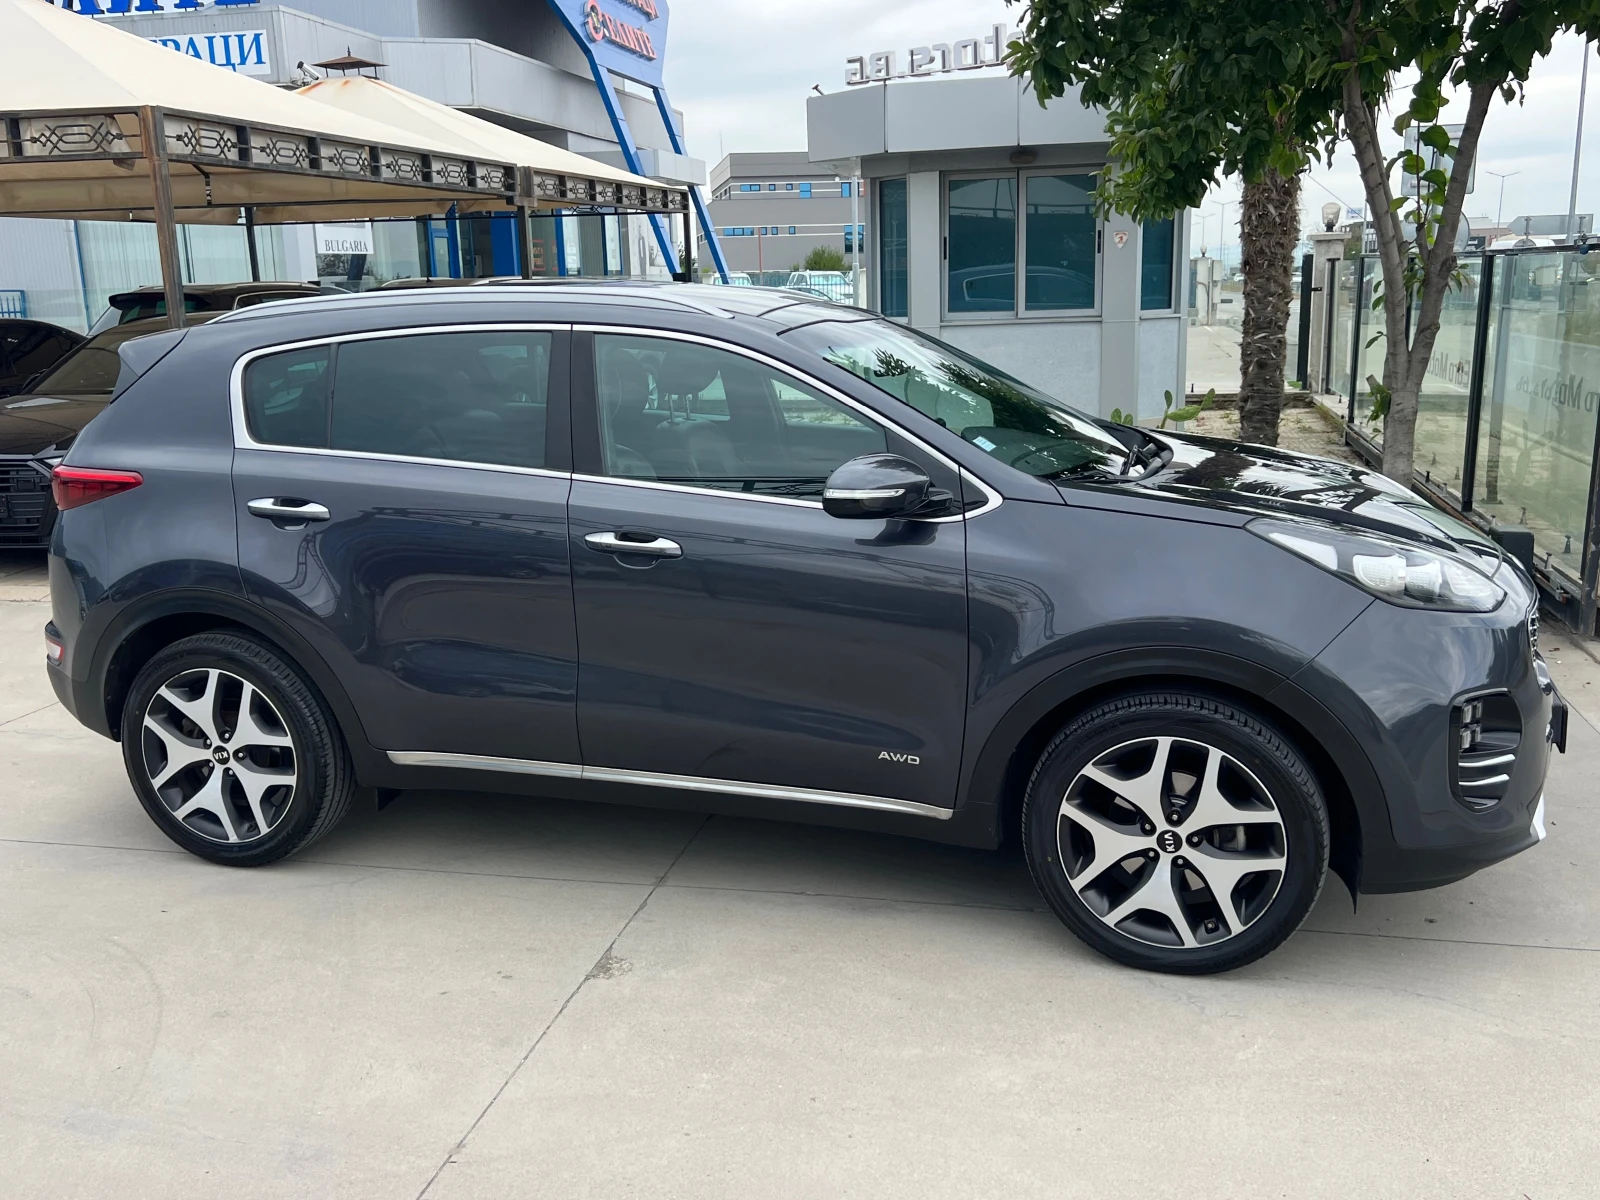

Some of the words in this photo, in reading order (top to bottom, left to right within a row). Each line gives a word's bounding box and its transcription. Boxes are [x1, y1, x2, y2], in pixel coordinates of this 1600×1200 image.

[325, 240, 368, 252] BULGARIA
[214, 751, 228, 760] KIA
[878, 751, 920, 765] AWD
[1164, 831, 1175, 852] KIA
